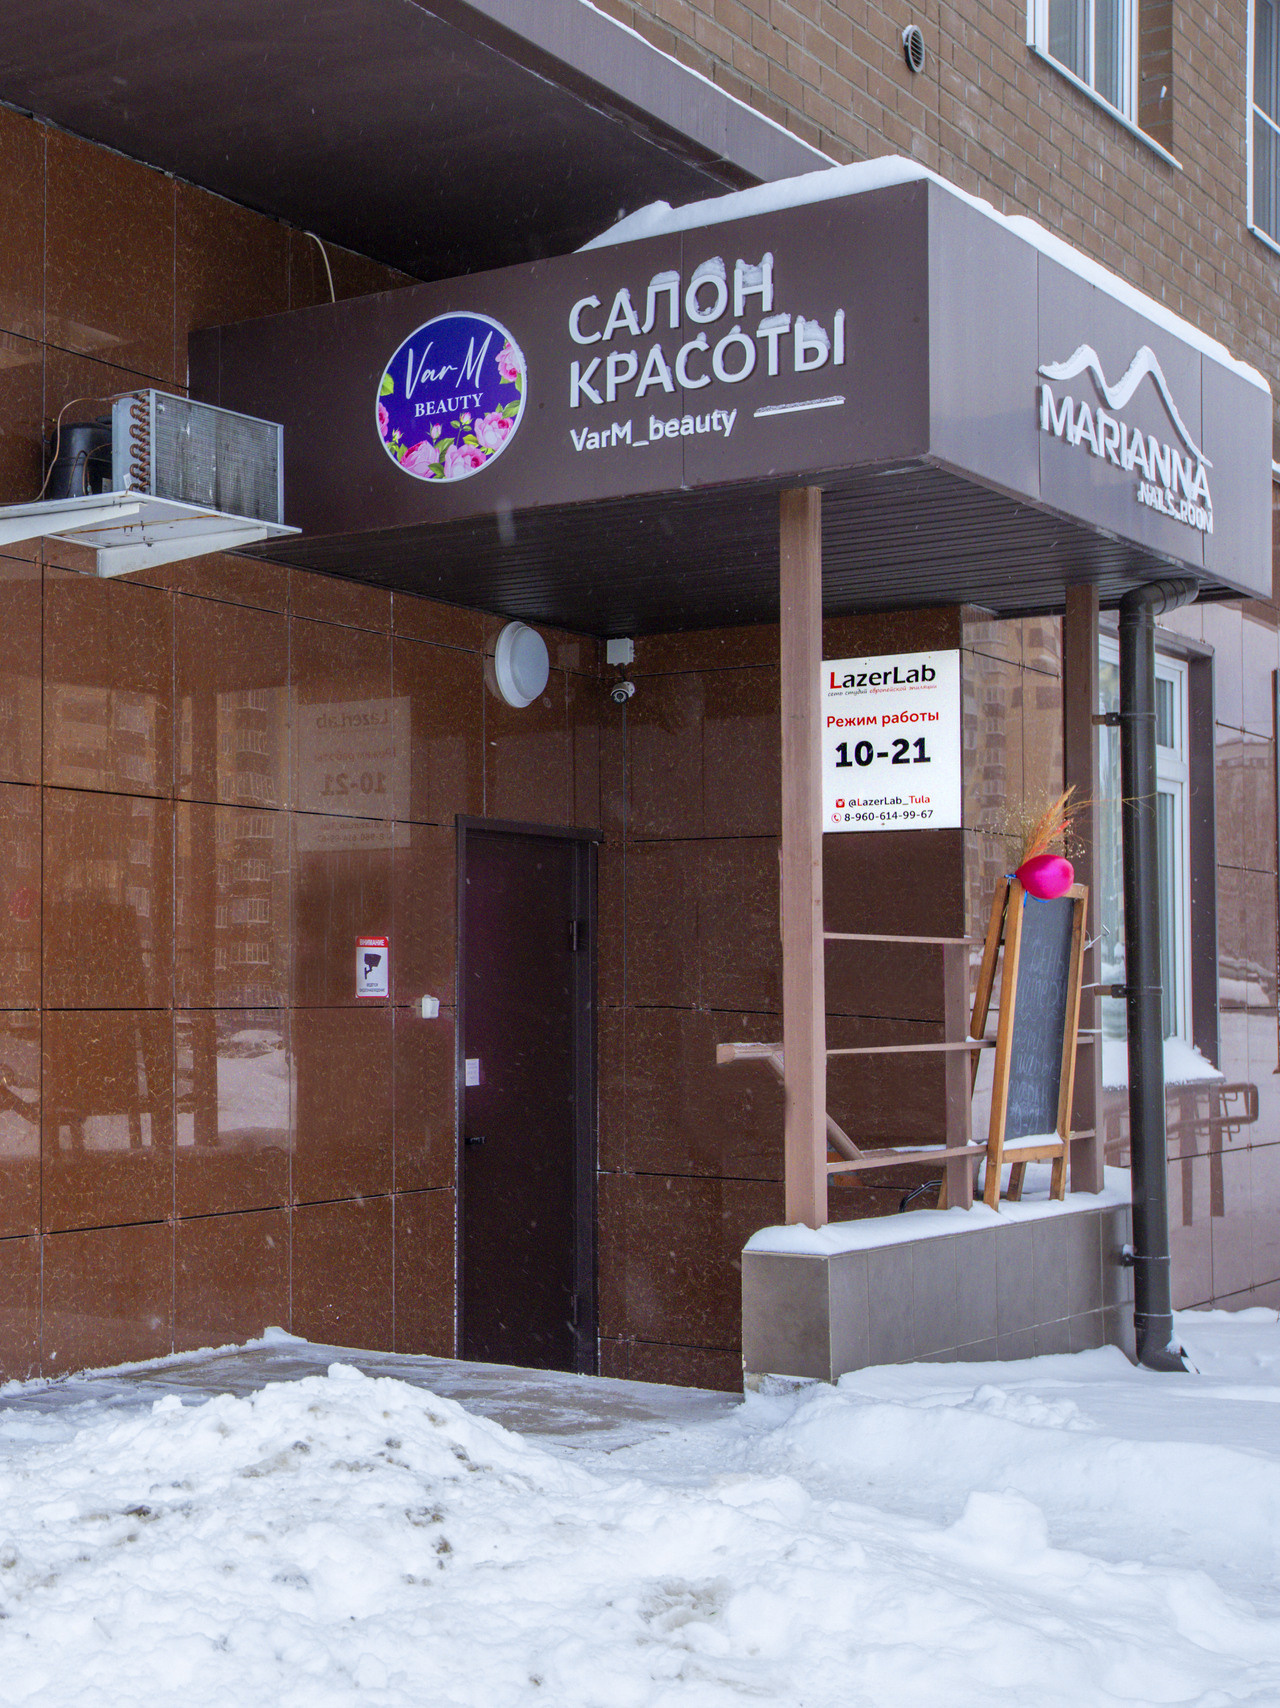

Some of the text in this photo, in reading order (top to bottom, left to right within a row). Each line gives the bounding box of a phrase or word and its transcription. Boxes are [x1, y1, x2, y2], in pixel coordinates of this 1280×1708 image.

[568, 254, 774, 345] САЛОН
[569, 310, 845, 409] КРАСОТЫ
[414, 392, 484, 418] BEAUTY
[570, 409, 737, 452] VarM_beauty
[1041, 384, 1213, 509] MARIANNA
[830, 664, 936, 689] LazerLab
[827, 711, 939, 728] Режим работы
[835, 737, 931, 768] 10-21
[848, 795, 931, 807] @LazerLab_Tula
[844, 810, 933, 822] 8-960-614-99-67
